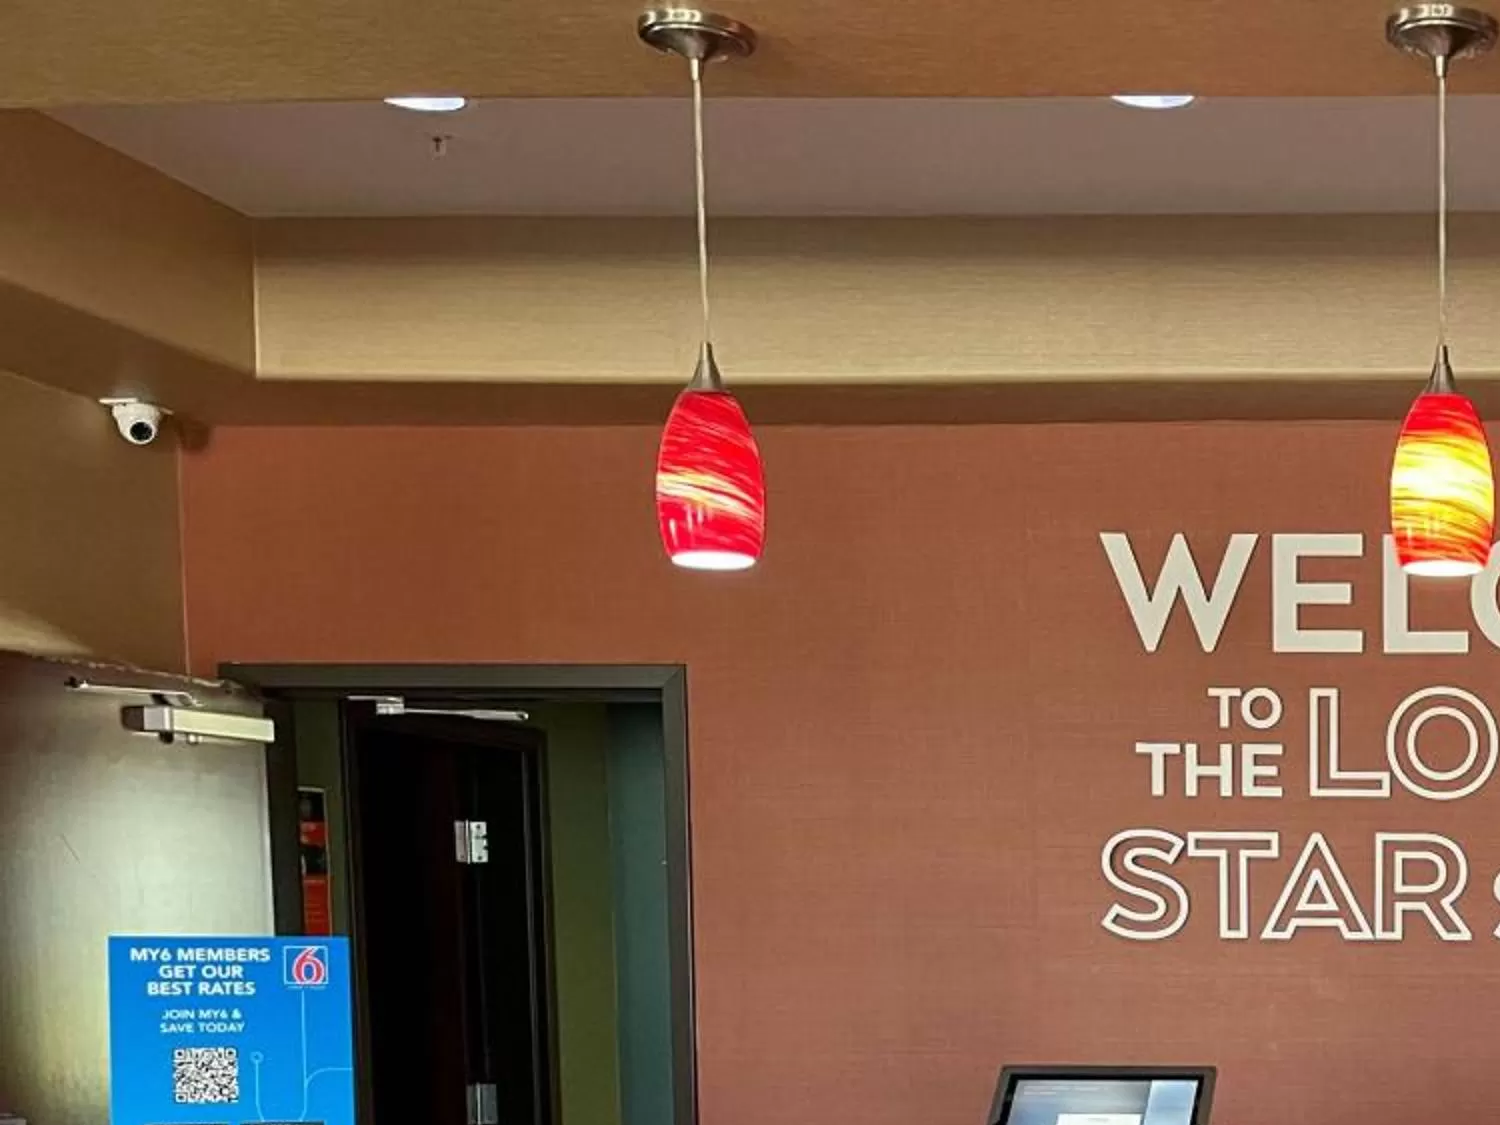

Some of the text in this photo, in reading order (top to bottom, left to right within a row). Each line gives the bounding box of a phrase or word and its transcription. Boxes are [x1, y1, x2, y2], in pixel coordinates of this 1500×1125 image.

[1208, 686, 1282, 730] TO
[1136, 742, 1283, 798] THE
[1101, 828, 1472, 942] STAR
[130, 948, 271, 962] MY6 MEMBERS
[159, 965, 244, 979] GET OUR
[292, 946, 325, 985] 6
[147, 982, 256, 996] BEST RATES
[162, 1009, 195, 1019] JOIN
[199, 1009, 227, 1019] MY6
[160, 1023, 245, 1034] SAVE TODAY
